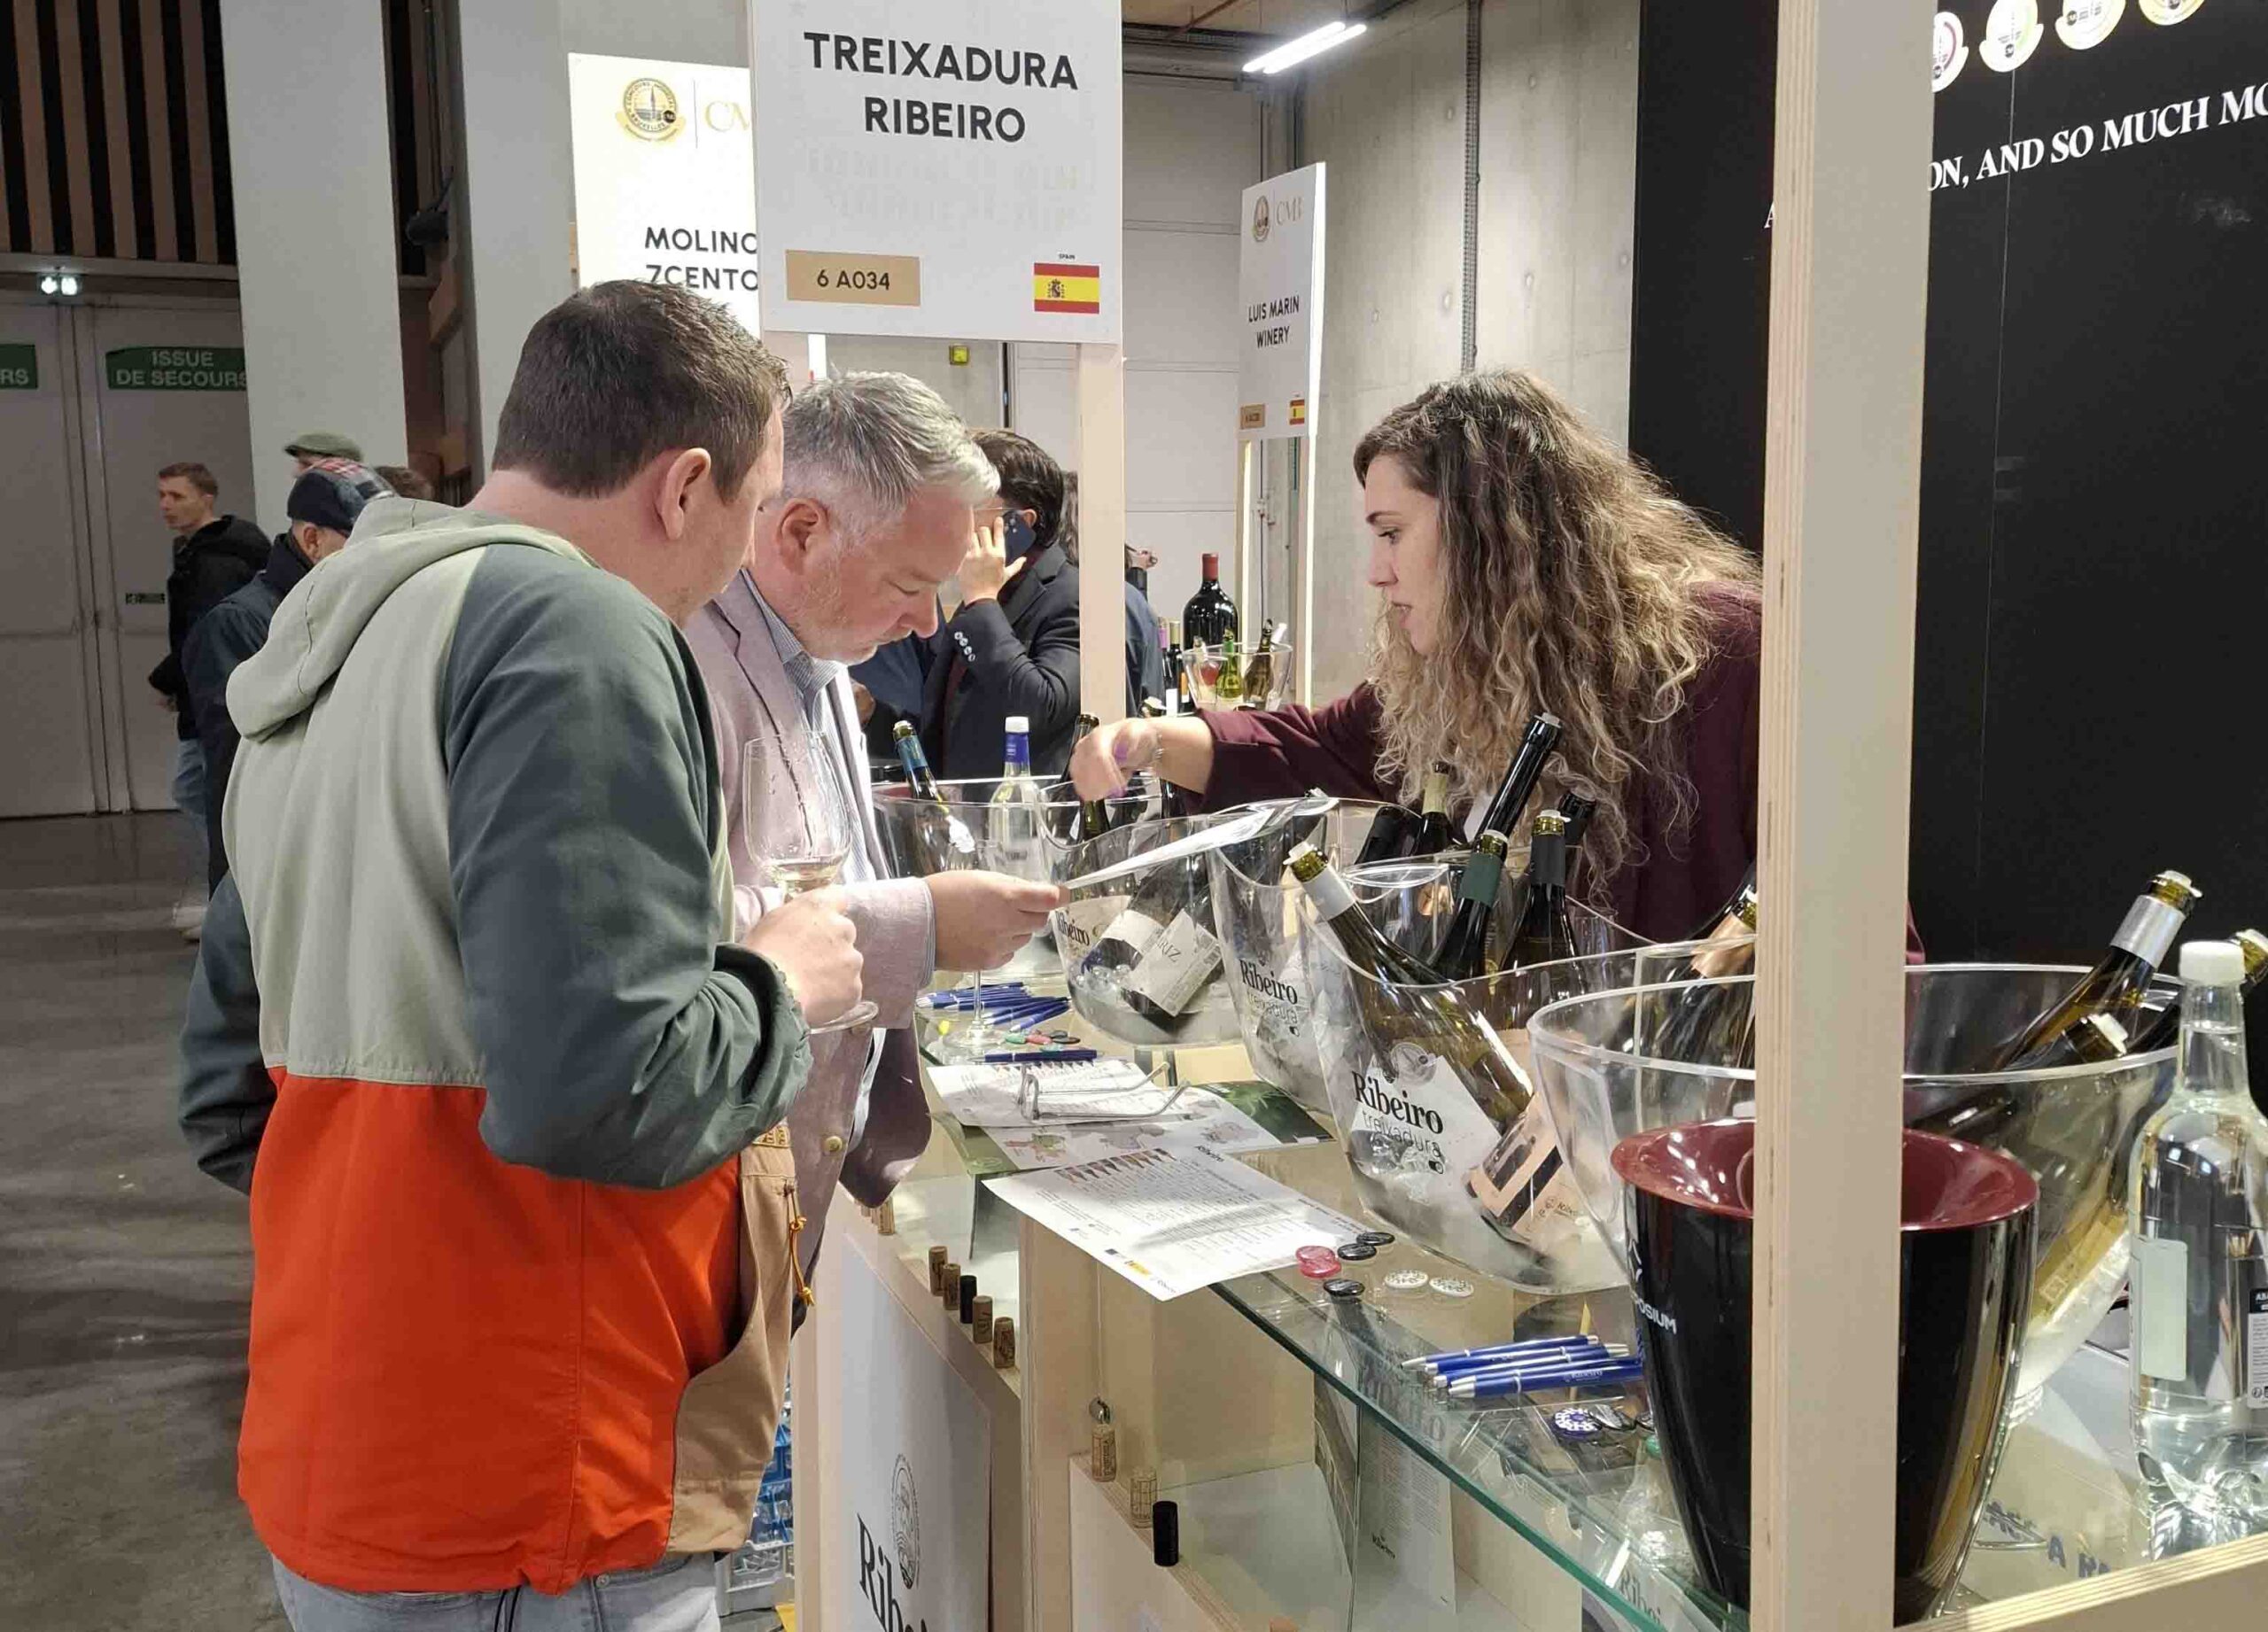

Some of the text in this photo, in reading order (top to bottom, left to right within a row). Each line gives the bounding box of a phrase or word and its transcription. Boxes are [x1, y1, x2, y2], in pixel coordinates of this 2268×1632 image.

[804, 32, 1078, 90] TREIXADURA
[866, 97, 1026, 143] RIBEIRO
[1976, 138, 2045, 180] AND
[2050, 125, 2094, 163] SO
[2100, 96, 2210, 152] MUCH
[817, 268, 890, 291] 6 A034
[1248, 294, 1300, 323] LUIS MARIN
[1255, 324, 1290, 350] WINERY
[117, 369, 145, 385] DE
[152, 351, 214, 367] ISSUE
[1239, 958, 1299, 1005] Ribeiro
[1351, 1069, 1444, 1135] Ribeiro
